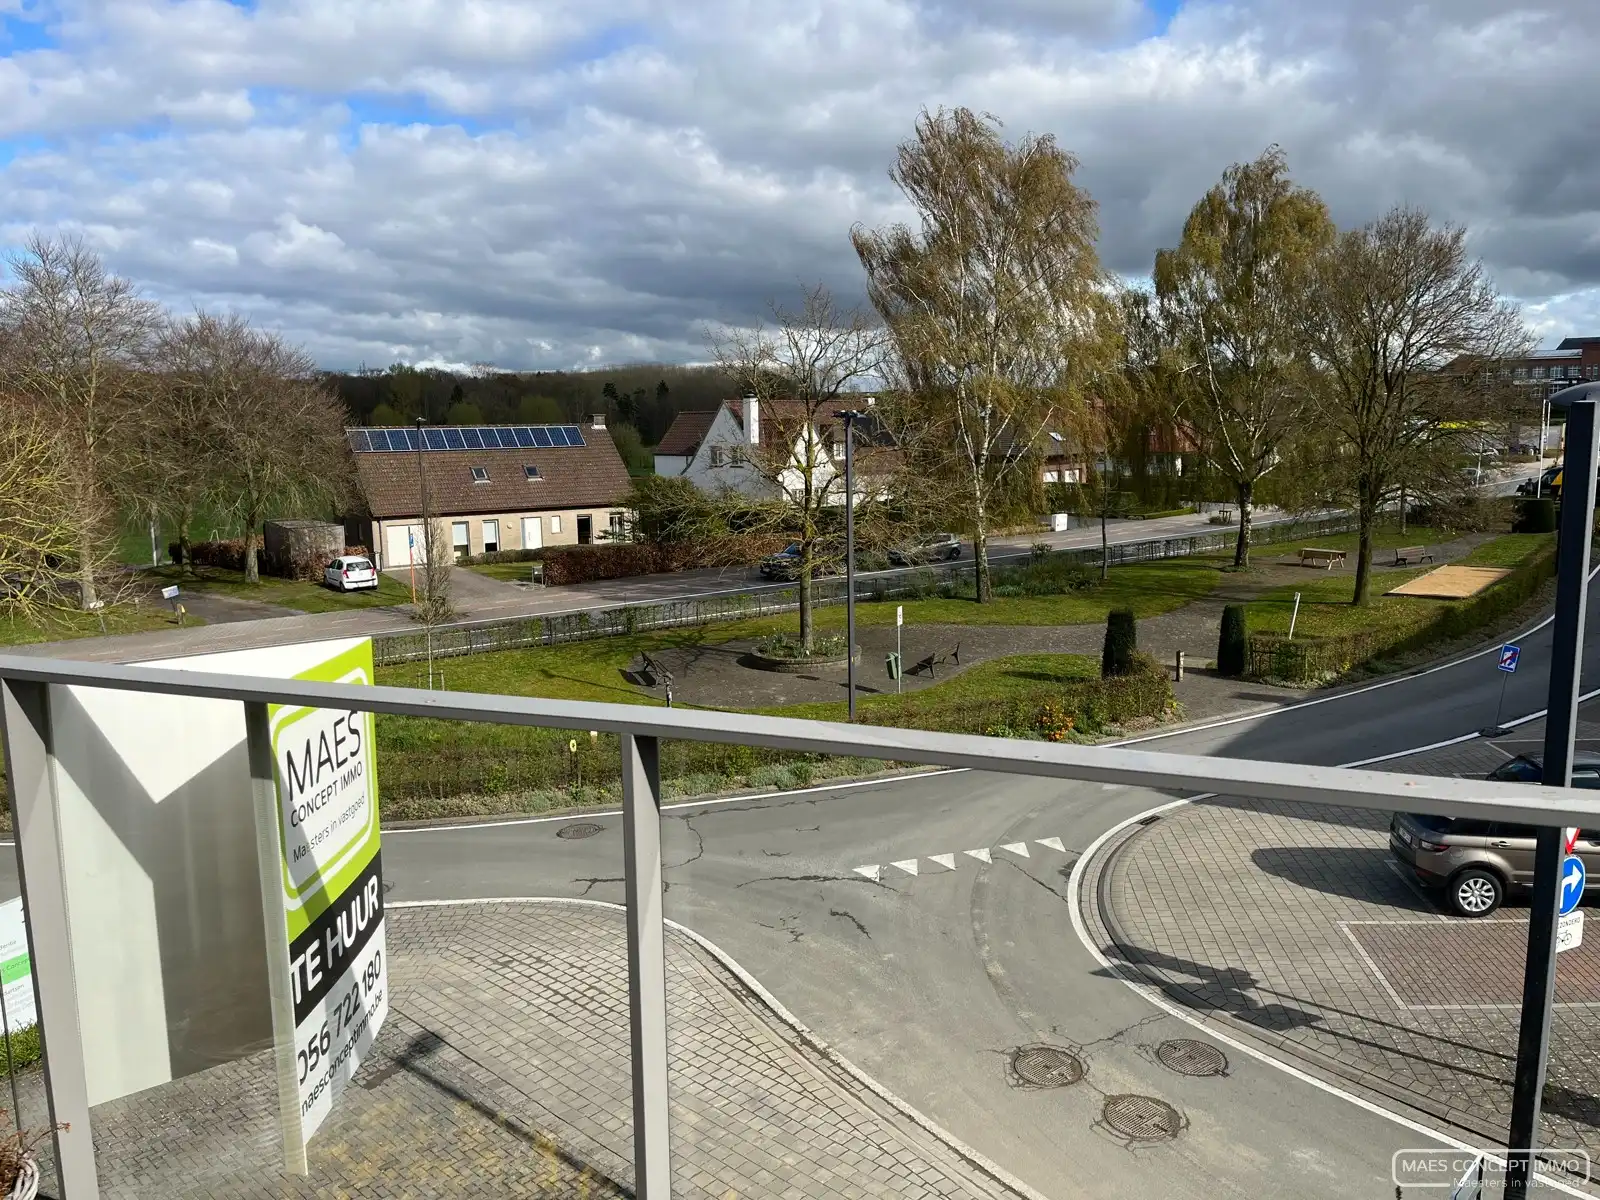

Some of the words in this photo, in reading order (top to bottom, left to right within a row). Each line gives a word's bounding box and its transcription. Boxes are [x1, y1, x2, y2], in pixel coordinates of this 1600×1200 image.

[287, 711, 361, 801] MAES
[291, 781, 338, 828] CONCEPT
[340, 761, 363, 791] IMMO
[293, 826, 330, 863] Maesters
[331, 819, 338, 836] in
[338, 791, 365, 826] vastgoed
[291, 939, 323, 1005] TE
[326, 875, 379, 969] HUUR
[334, 982, 361, 1038] 722
[362, 950, 381, 998] 180
